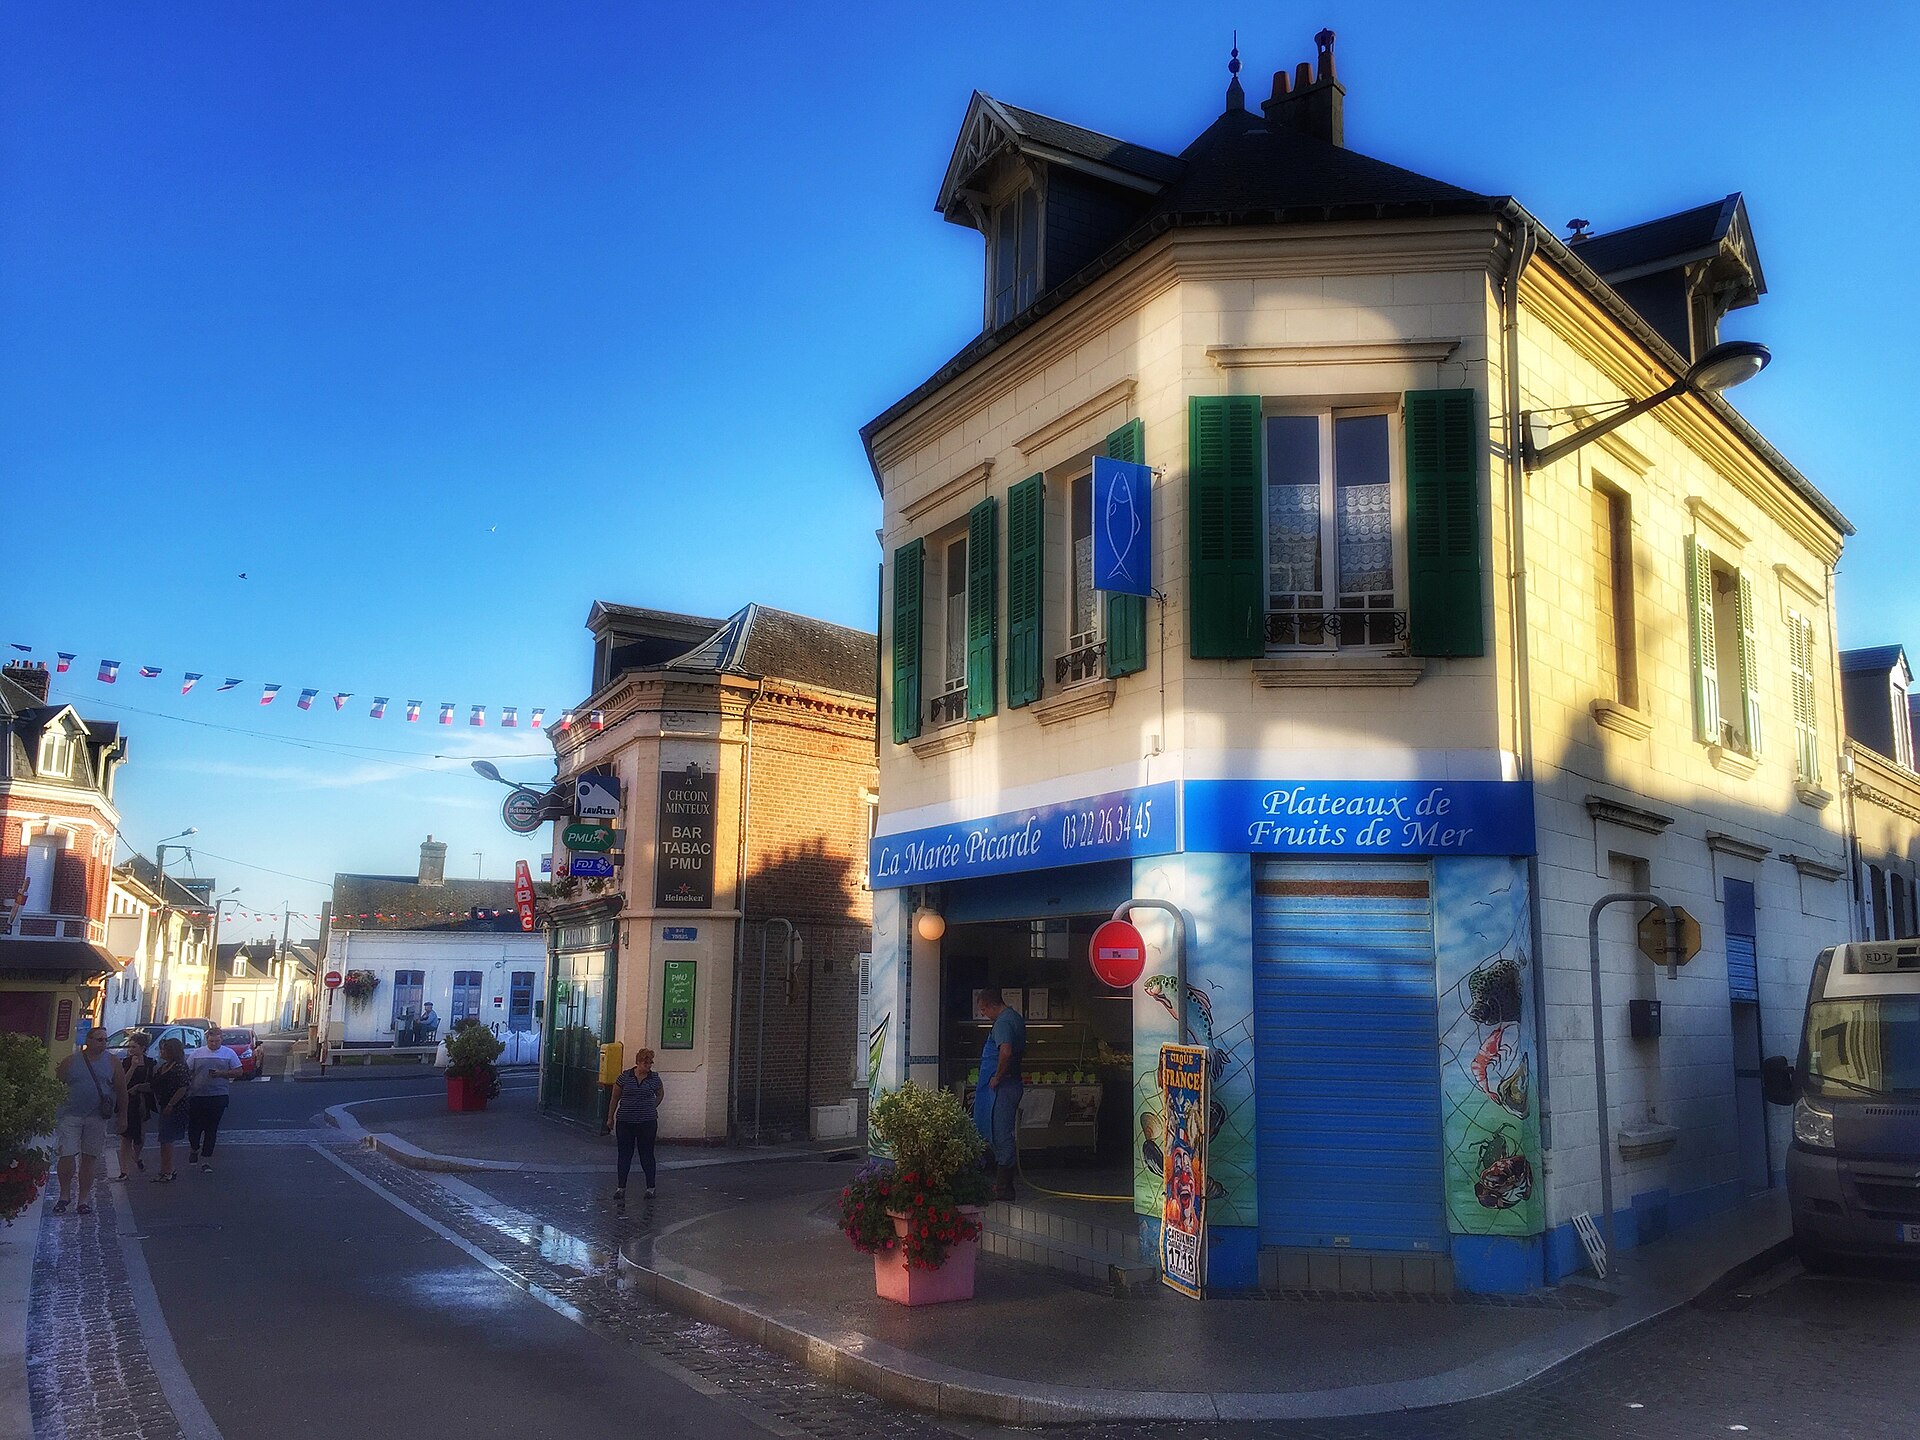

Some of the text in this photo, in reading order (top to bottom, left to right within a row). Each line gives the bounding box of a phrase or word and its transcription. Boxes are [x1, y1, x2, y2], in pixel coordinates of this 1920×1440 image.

[665, 803, 710, 815] MINTEUX
[1262, 786, 1451, 821] Plateaux de
[582, 806, 616, 815] LAVAZZA
[568, 832, 593, 843] PMU
[672, 826, 702, 839] BAR
[876, 799, 1152, 877] La Marée Picarde 03 22 26 34 45
[1248, 818, 1474, 847] Fruits de Mer
[662, 841, 711, 855] TABAC
[576, 860, 594, 869] FDJ
[670, 857, 702, 870] PMU
[516, 863, 532, 929] TABAC
[665, 894, 704, 902] Heineken
[1865, 952, 1889, 962] EDT
[1170, 1052, 1194, 1066] CIRQUE
[1166, 1069, 1200, 1091] FRANCE
